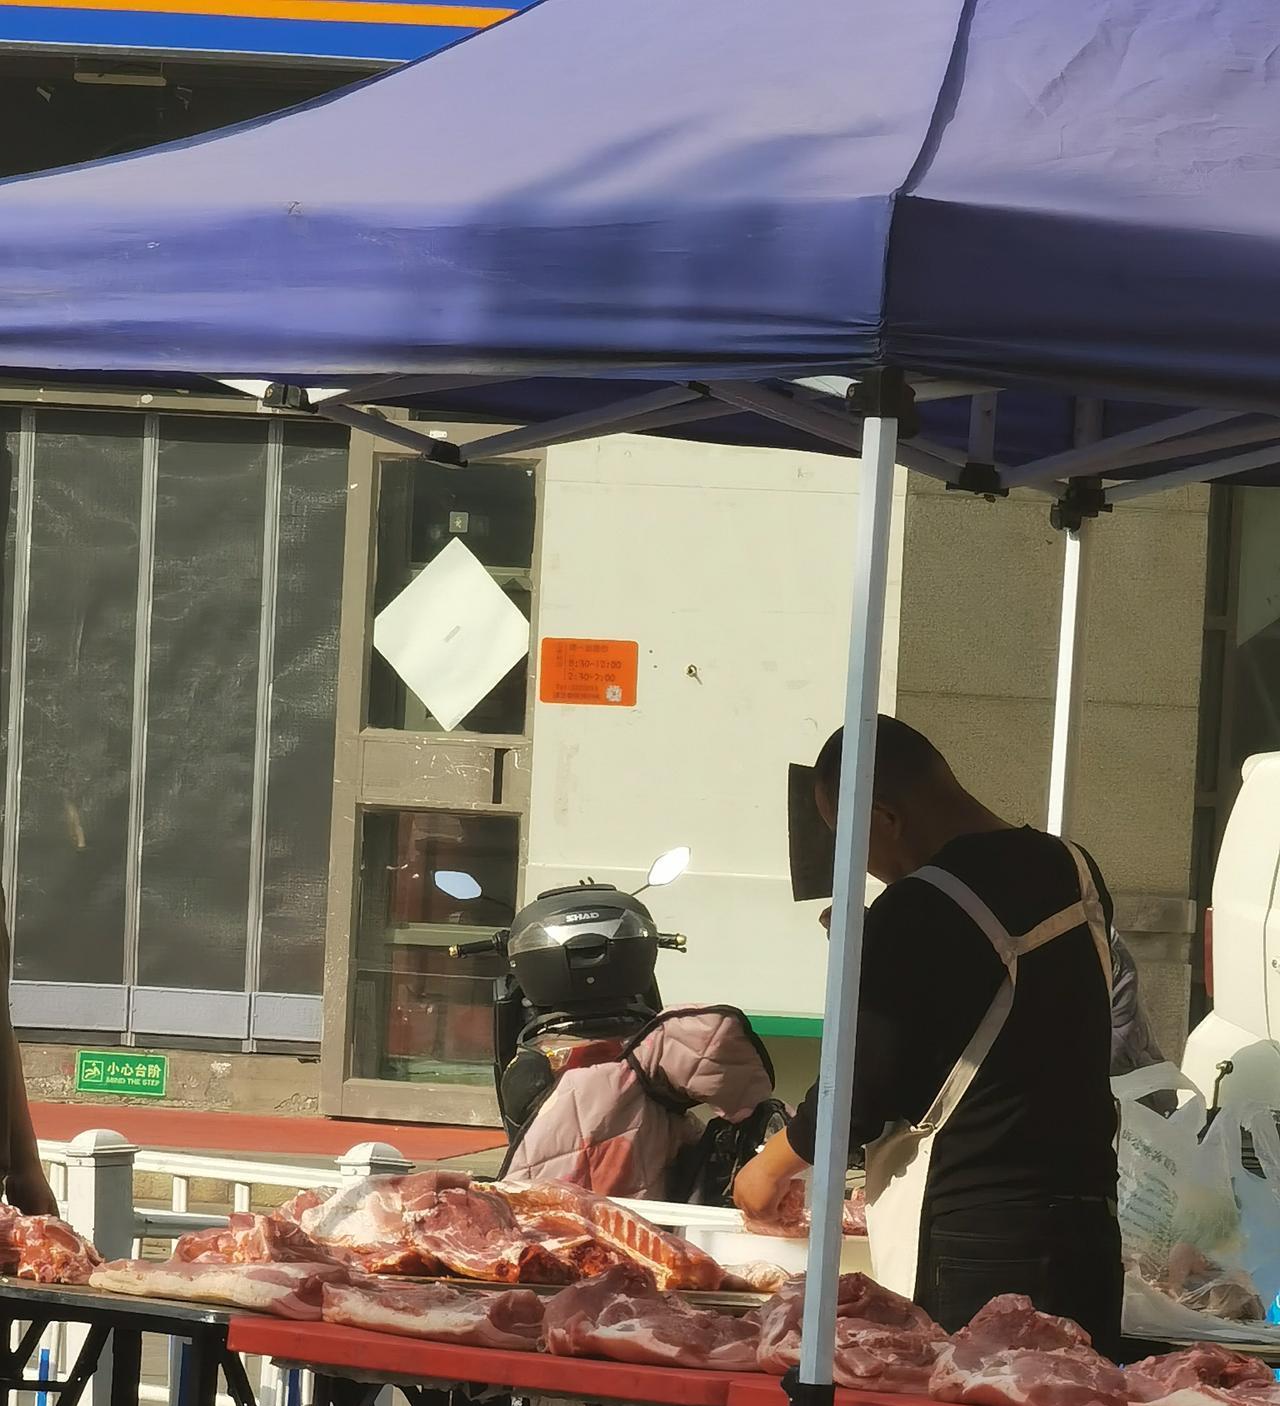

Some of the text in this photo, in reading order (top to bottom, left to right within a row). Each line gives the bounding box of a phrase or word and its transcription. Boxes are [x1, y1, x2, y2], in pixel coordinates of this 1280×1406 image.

[566, 912, 599, 922] SHAD
[107, 1062, 162, 1078] 小心台阶
[106, 1076, 126, 1085] MIND
[142, 1079, 160, 1087] STEP
